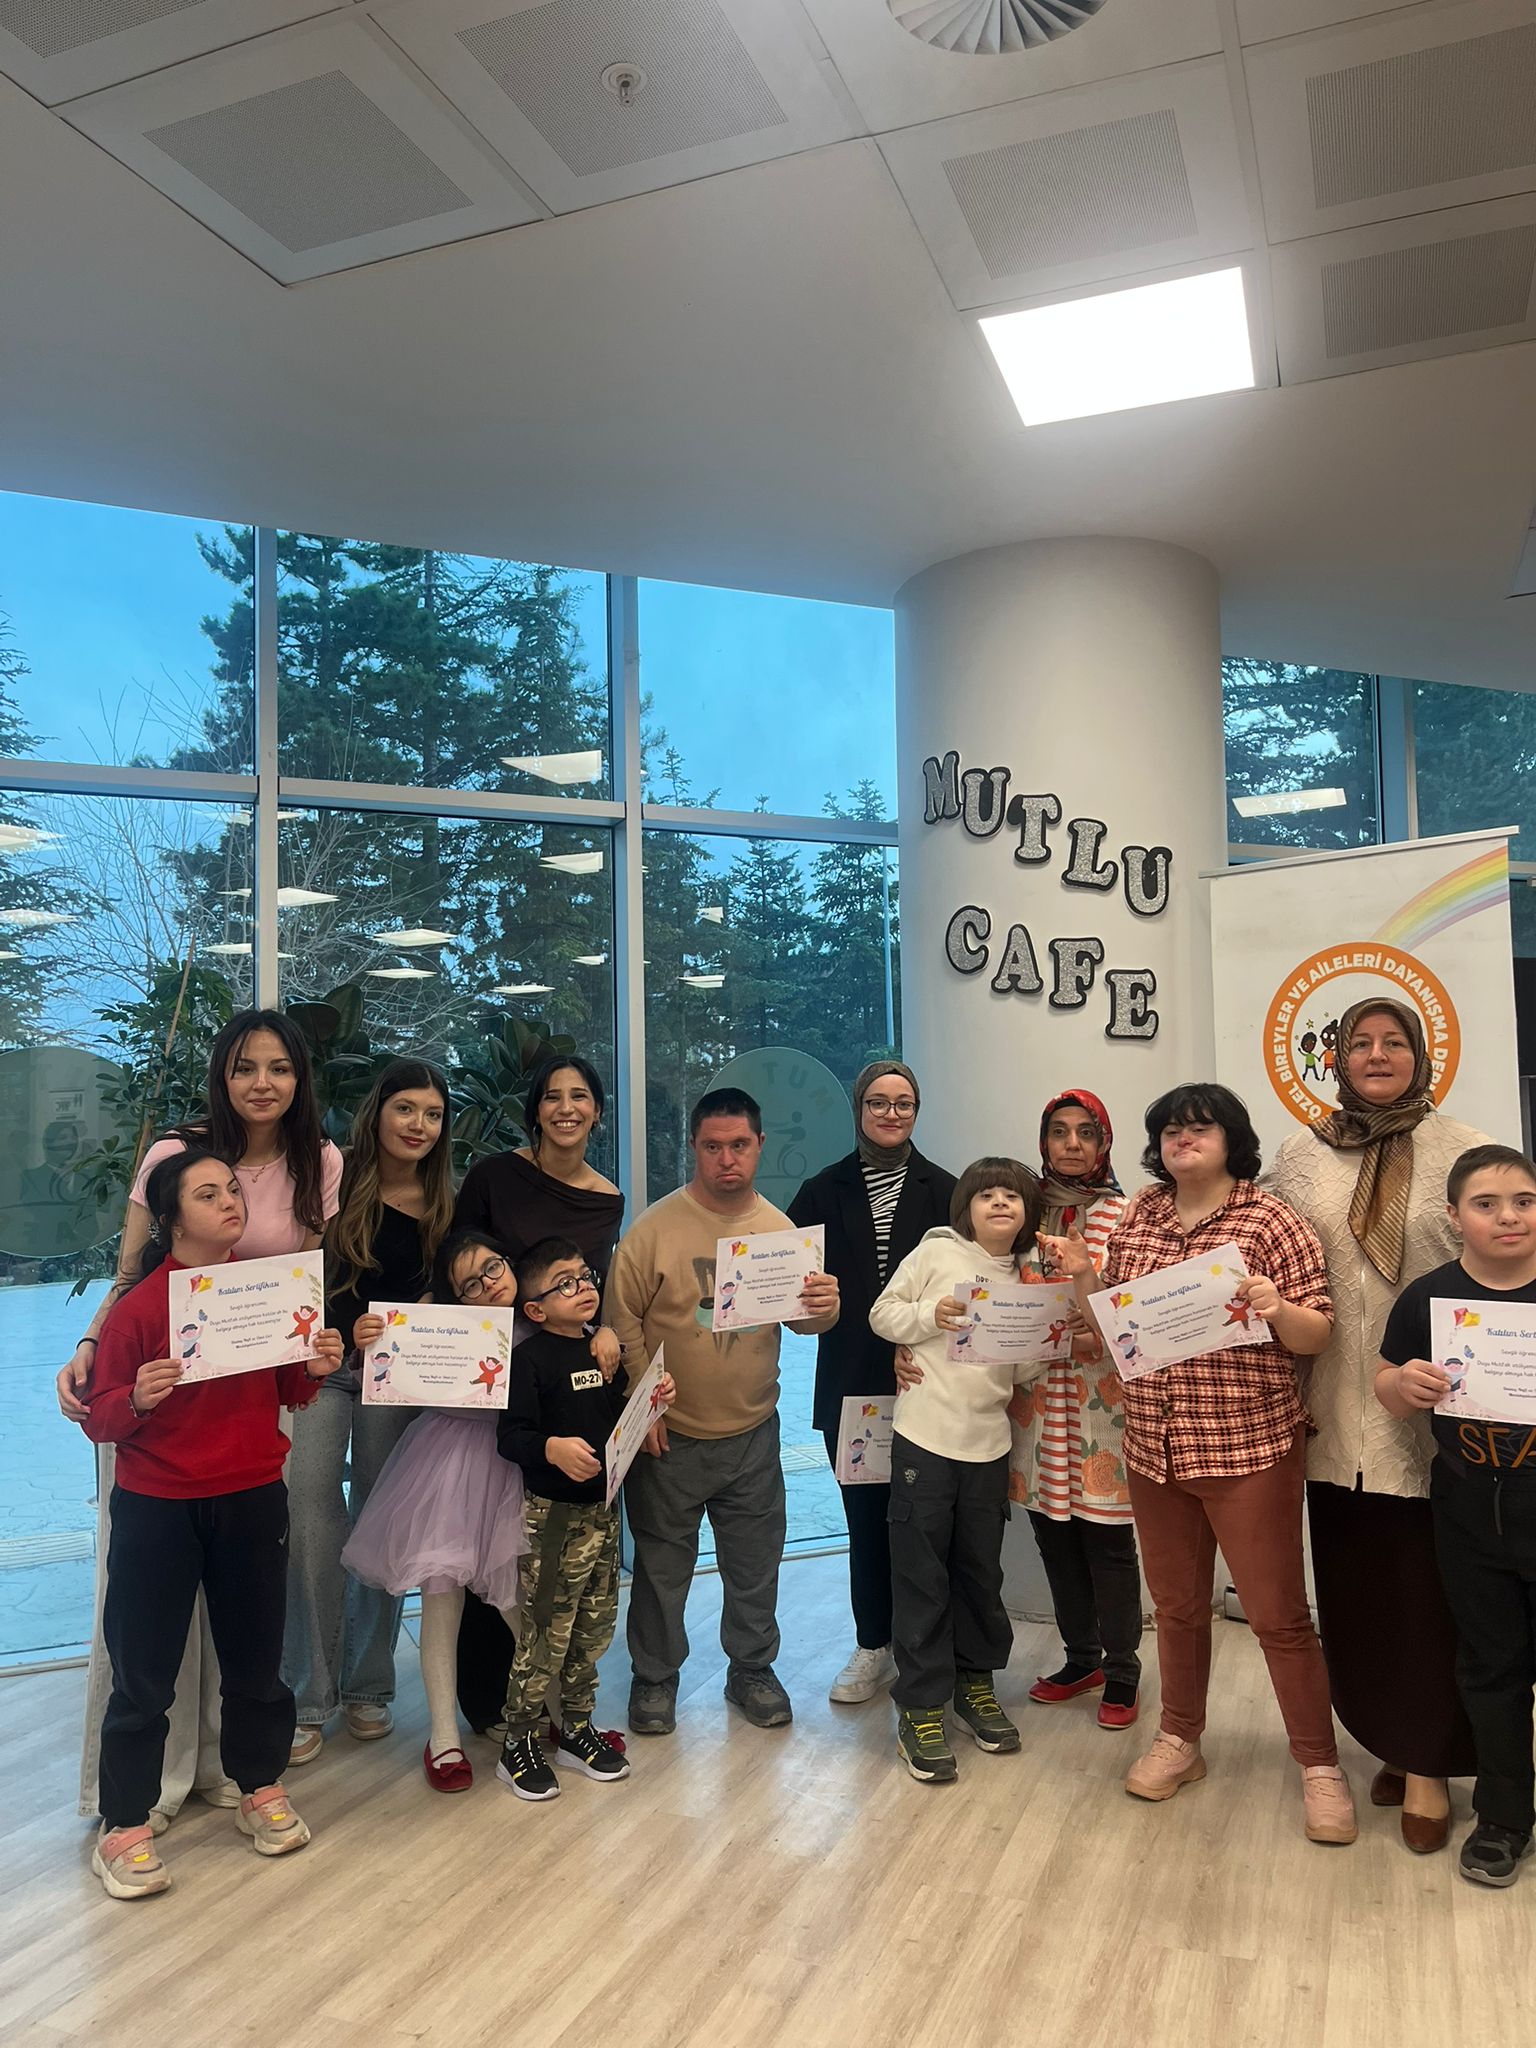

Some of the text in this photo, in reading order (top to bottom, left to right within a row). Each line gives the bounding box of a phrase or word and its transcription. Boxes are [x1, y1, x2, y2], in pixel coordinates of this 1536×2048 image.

[923, 750, 1172, 916] MUTLU
[945, 905, 1159, 1040] CAFE
[1289, 978, 1310, 1000] VE
[1308, 952, 1382, 984] AİLELERİ
[1383, 957, 1449, 1046] DAYANIŞMA
[1274, 1001, 1295, 1083] BİREYLER
[1289, 1085, 1322, 1120] ÖZEL
